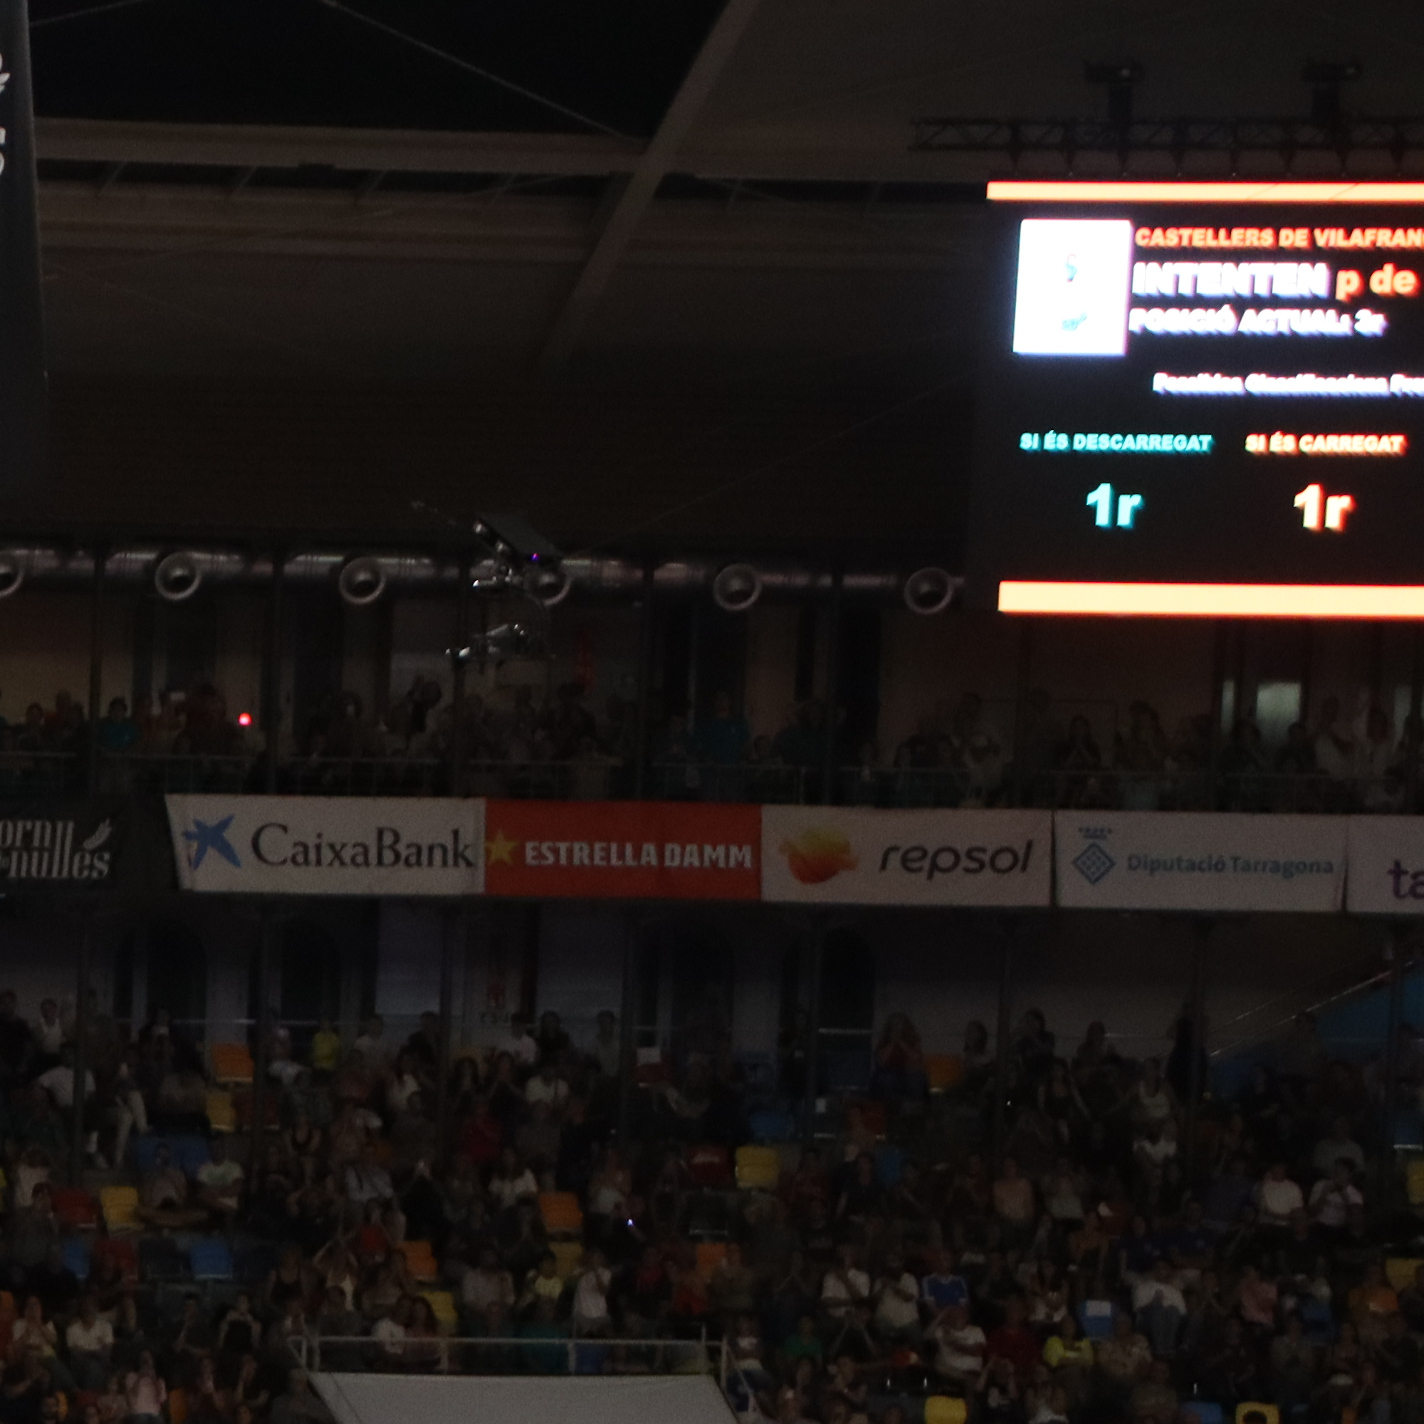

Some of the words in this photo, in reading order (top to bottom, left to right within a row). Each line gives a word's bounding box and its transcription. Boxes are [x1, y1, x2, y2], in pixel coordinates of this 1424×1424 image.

[1134, 228, 1274, 248] CASTELLERS
[1278, 228, 1309, 248] DE
[1132, 262, 1330, 298] INTENTEN
[1335, 268, 1360, 301] p
[1369, 263, 1417, 296] de
[1020, 433, 1040, 451] SI
[1043, 430, 1069, 451] ÉS
[1072, 434, 1214, 452] DESCARREGAT
[1245, 435, 1267, 453] SI
[1270, 432, 1295, 453] ÉS
[1299, 435, 1408, 454] CARREGAT
[1085, 483, 1144, 527] 1r
[1293, 484, 1355, 531] 1r
[252, 822, 477, 870] CaixaBank
[524, 840, 654, 868] ESTRELLA
[663, 842, 752, 869] DAMM
[878, 839, 1034, 881] repsol
[1126, 854, 1227, 877] Diputació
[1228, 856, 1335, 879] Tarragona
[1387, 859, 1424, 900] ta
